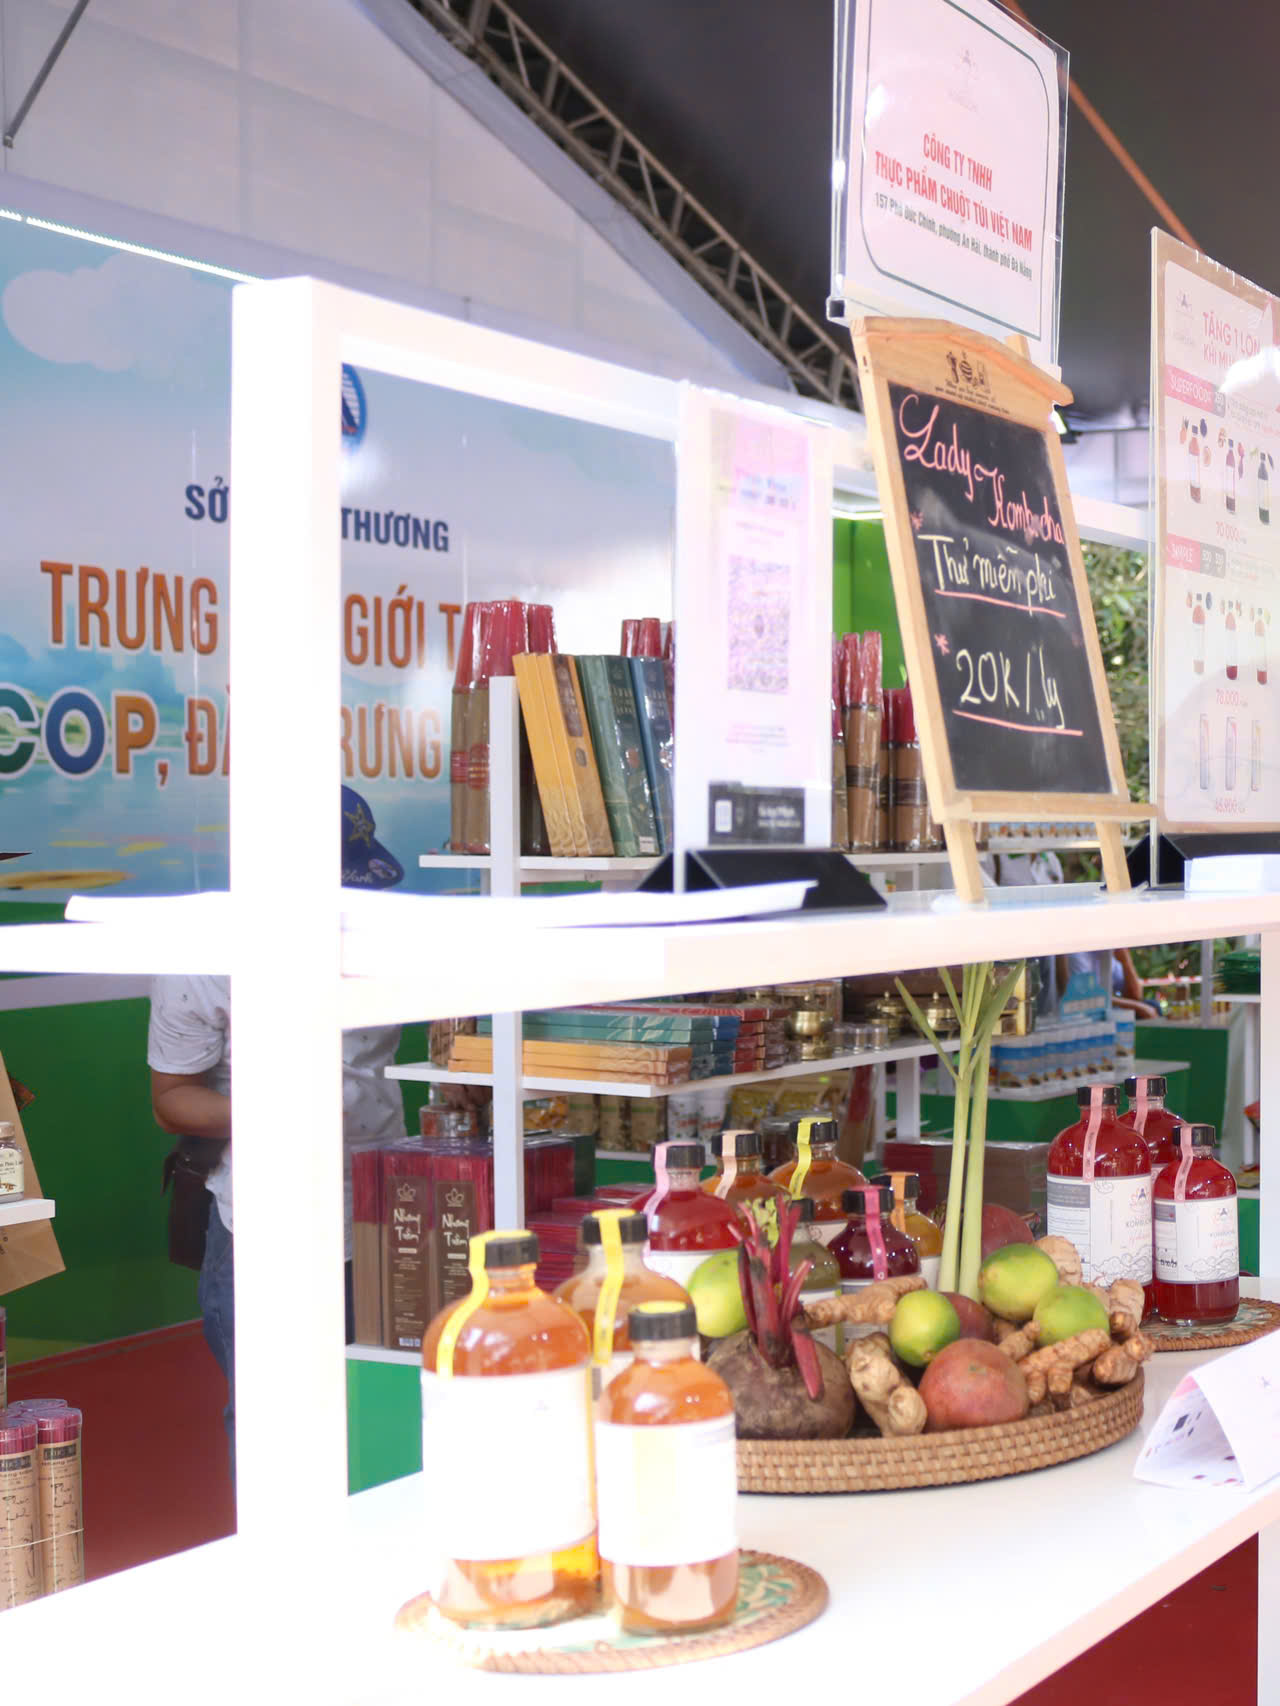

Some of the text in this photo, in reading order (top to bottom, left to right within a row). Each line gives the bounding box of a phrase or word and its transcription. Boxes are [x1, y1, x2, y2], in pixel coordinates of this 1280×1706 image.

[923, 132, 993, 192] CÔNG TY TNHH
[875, 192, 889, 209] 157
[875, 151, 1033, 252] THỰC PHẨM CHUỘT TÚI VIỆT NAM
[900, 394, 974, 502] Lady
[185, 475, 229, 523] SỞ
[341, 507, 449, 552] THƯƠNG
[917, 534, 969, 591] Thử
[41, 560, 219, 655] TRƯNG
[344, 584, 426, 670] GIỚI
